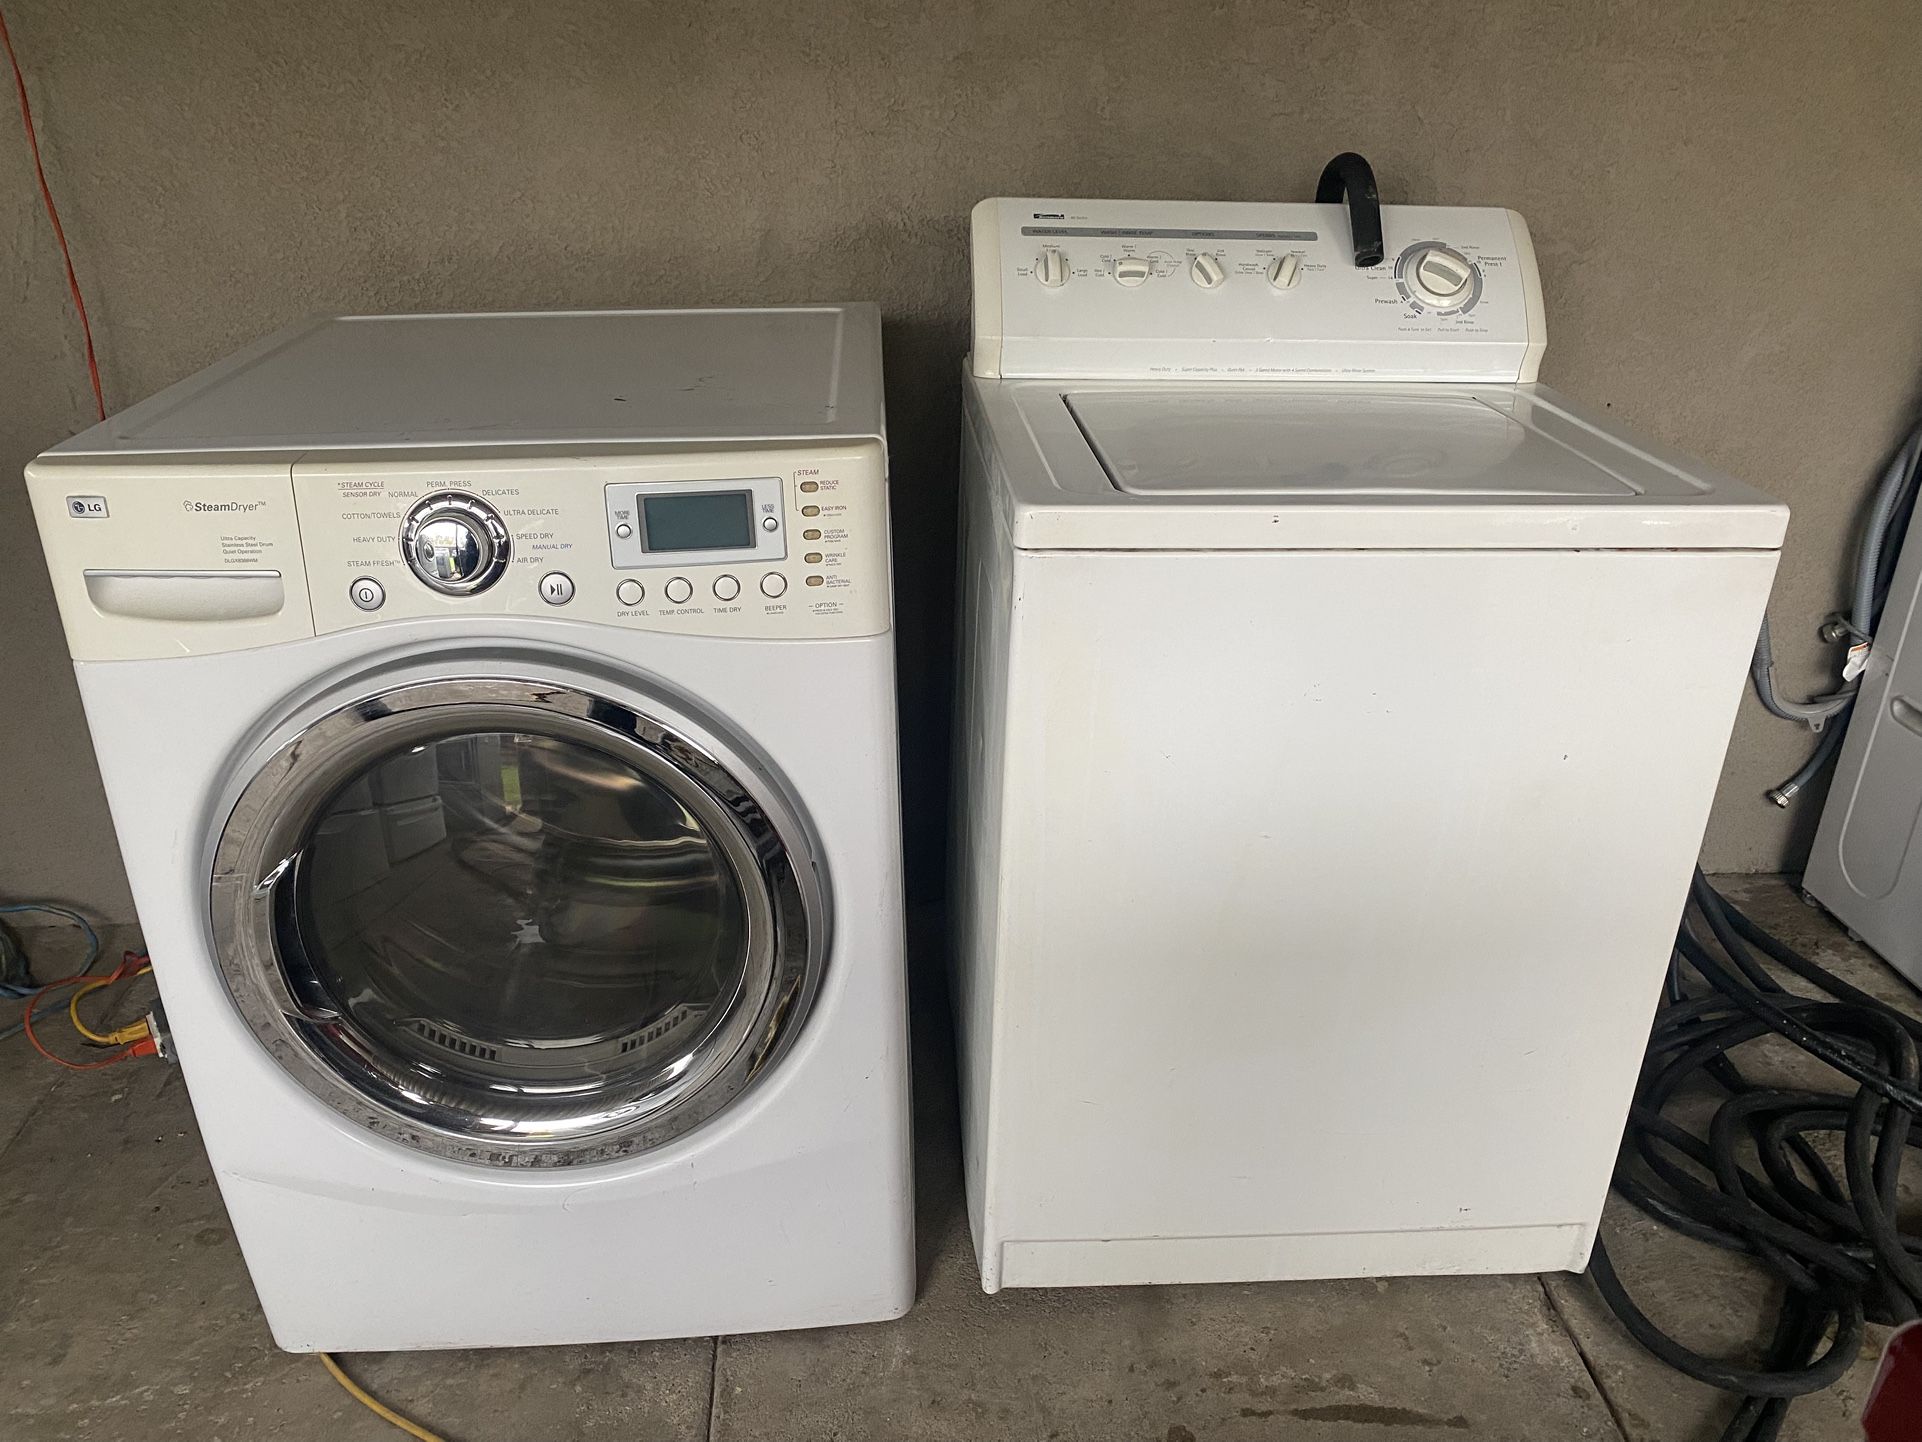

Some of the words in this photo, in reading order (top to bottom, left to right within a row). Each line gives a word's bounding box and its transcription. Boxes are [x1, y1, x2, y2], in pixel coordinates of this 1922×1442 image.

[87, 503, 102, 512] LG
[341, 512, 401, 520] COTTON/TOWELS
[527, 508, 559, 516] DELICATE
